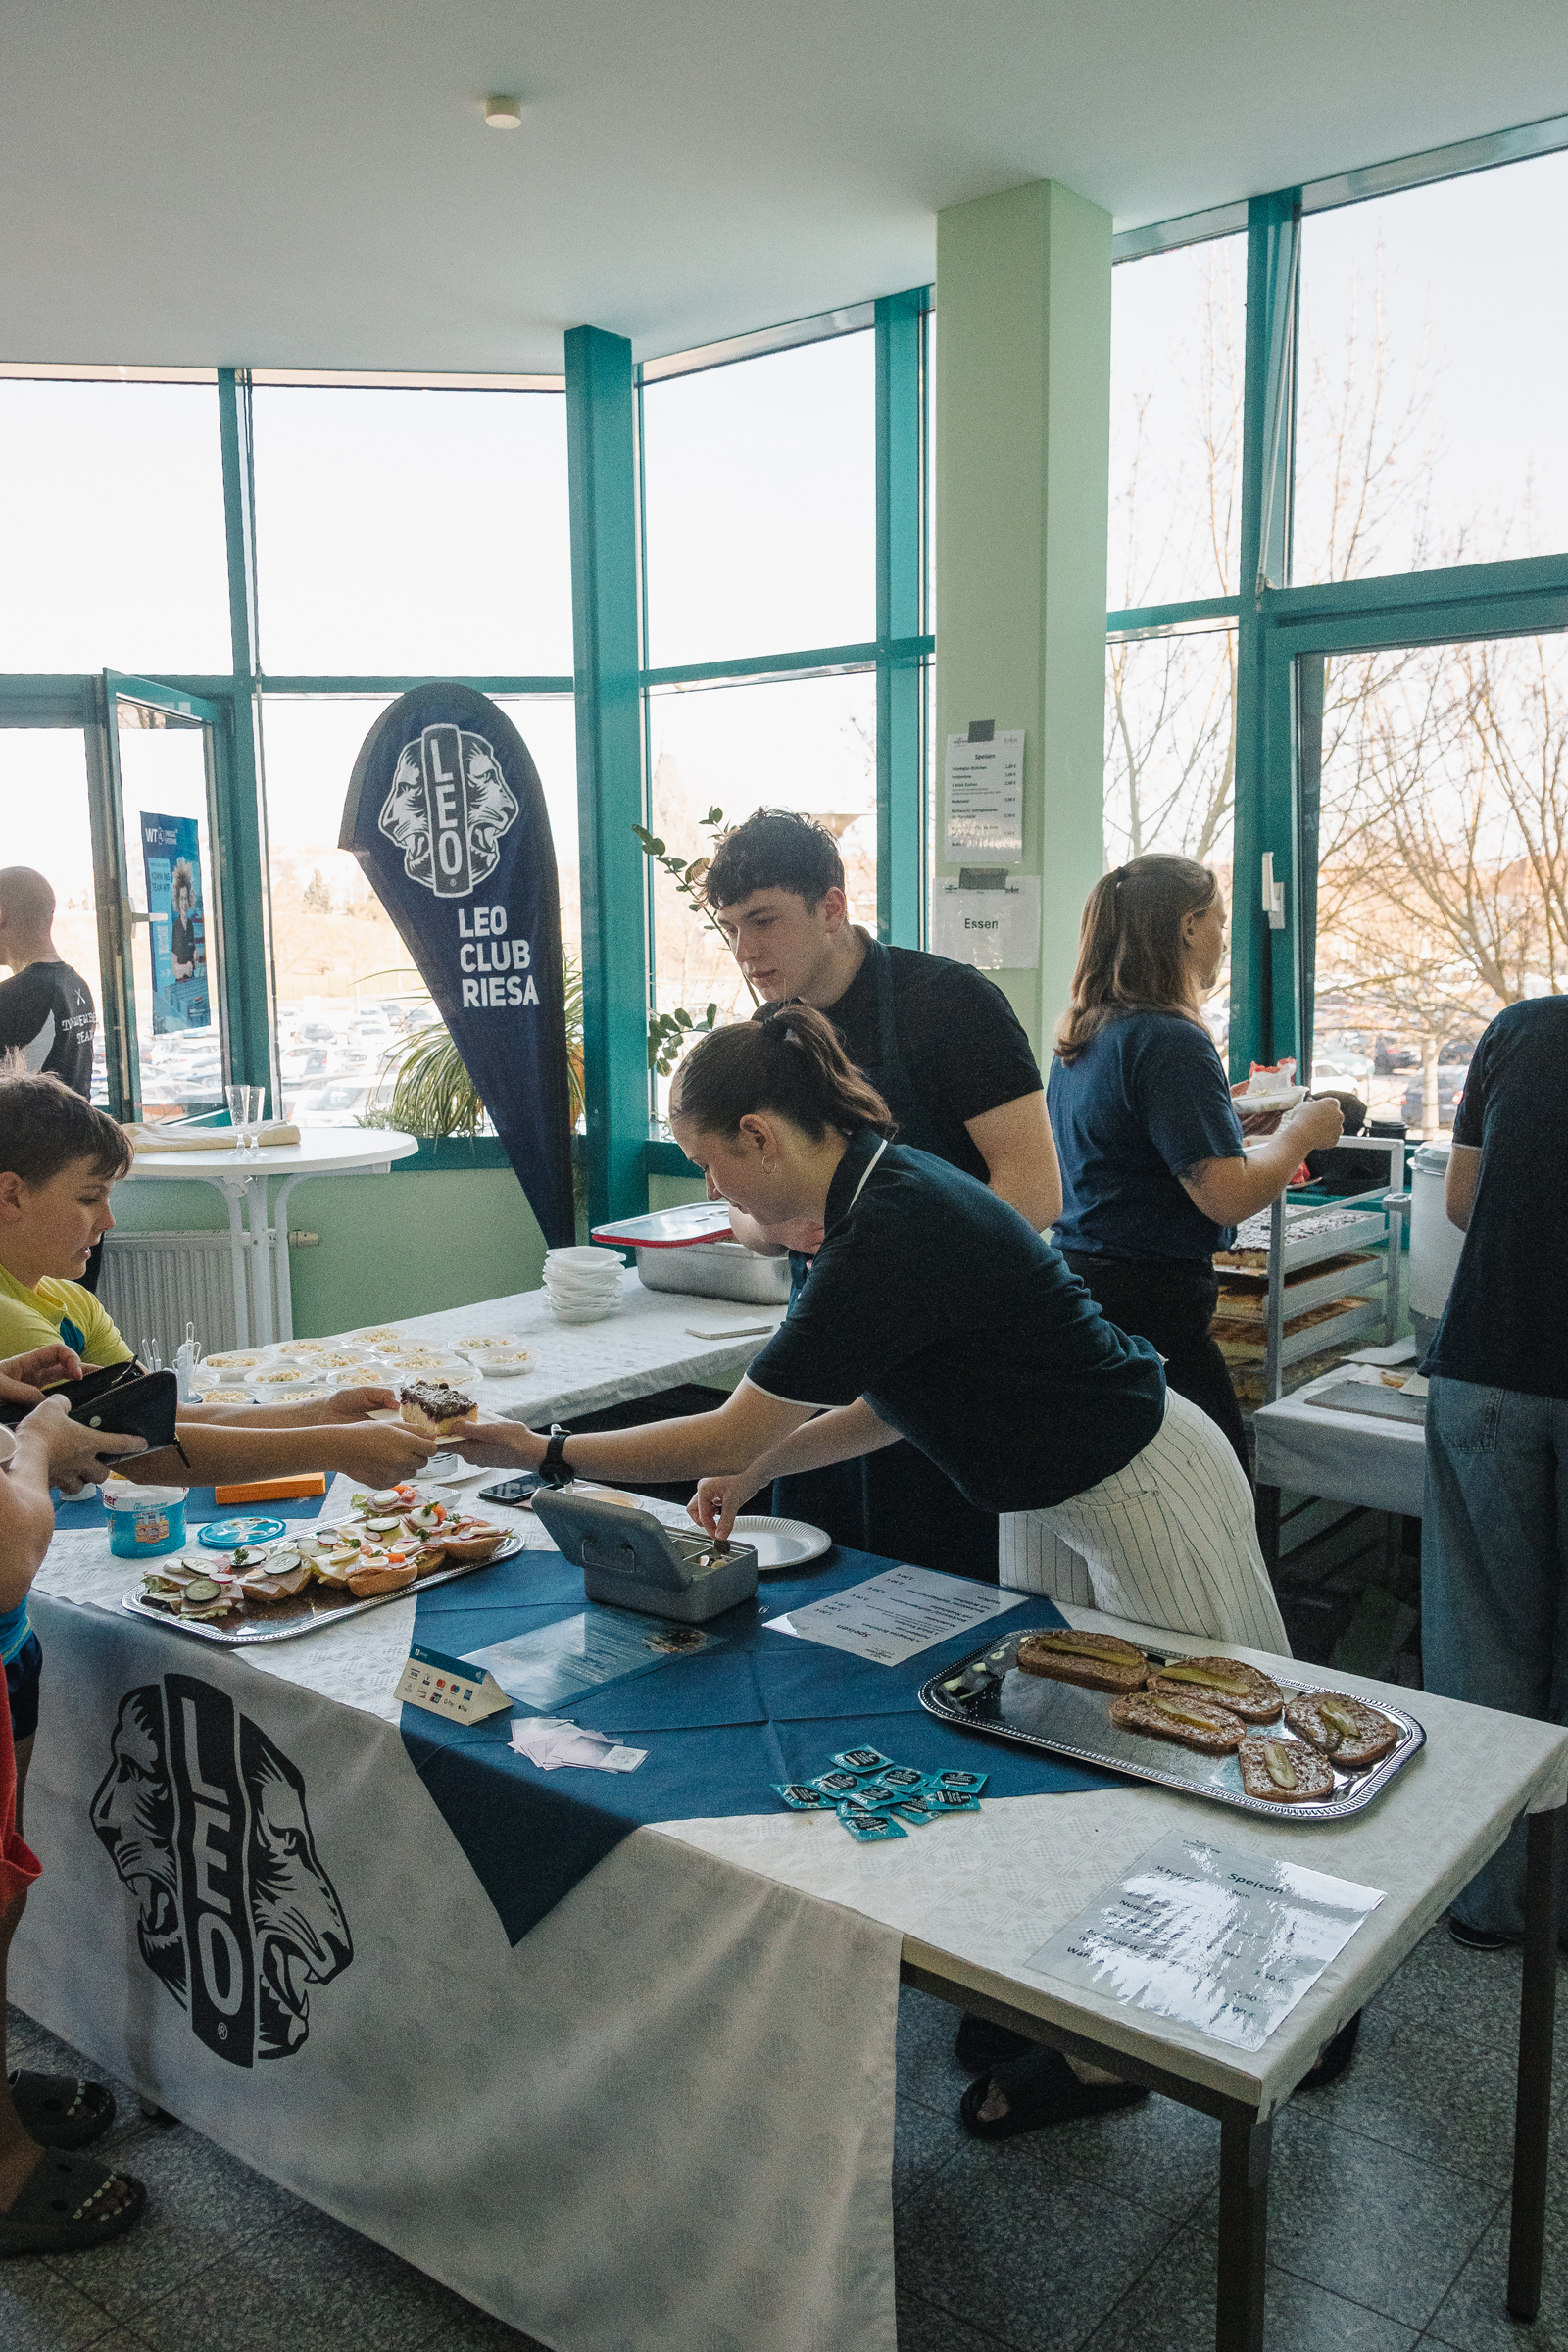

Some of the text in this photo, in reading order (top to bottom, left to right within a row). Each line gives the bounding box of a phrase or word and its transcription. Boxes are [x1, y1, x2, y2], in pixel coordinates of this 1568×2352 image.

[431, 739, 463, 875] LEO
[458, 905, 508, 938] LEO
[964, 918, 999, 929] Essen
[460, 939, 531, 973] CLUB
[462, 974, 540, 1008] RIESA
[832, 1624, 872, 1637] Speisen
[181, 1697, 243, 2016] LEO
[1225, 1872, 1286, 1895] Speisen
